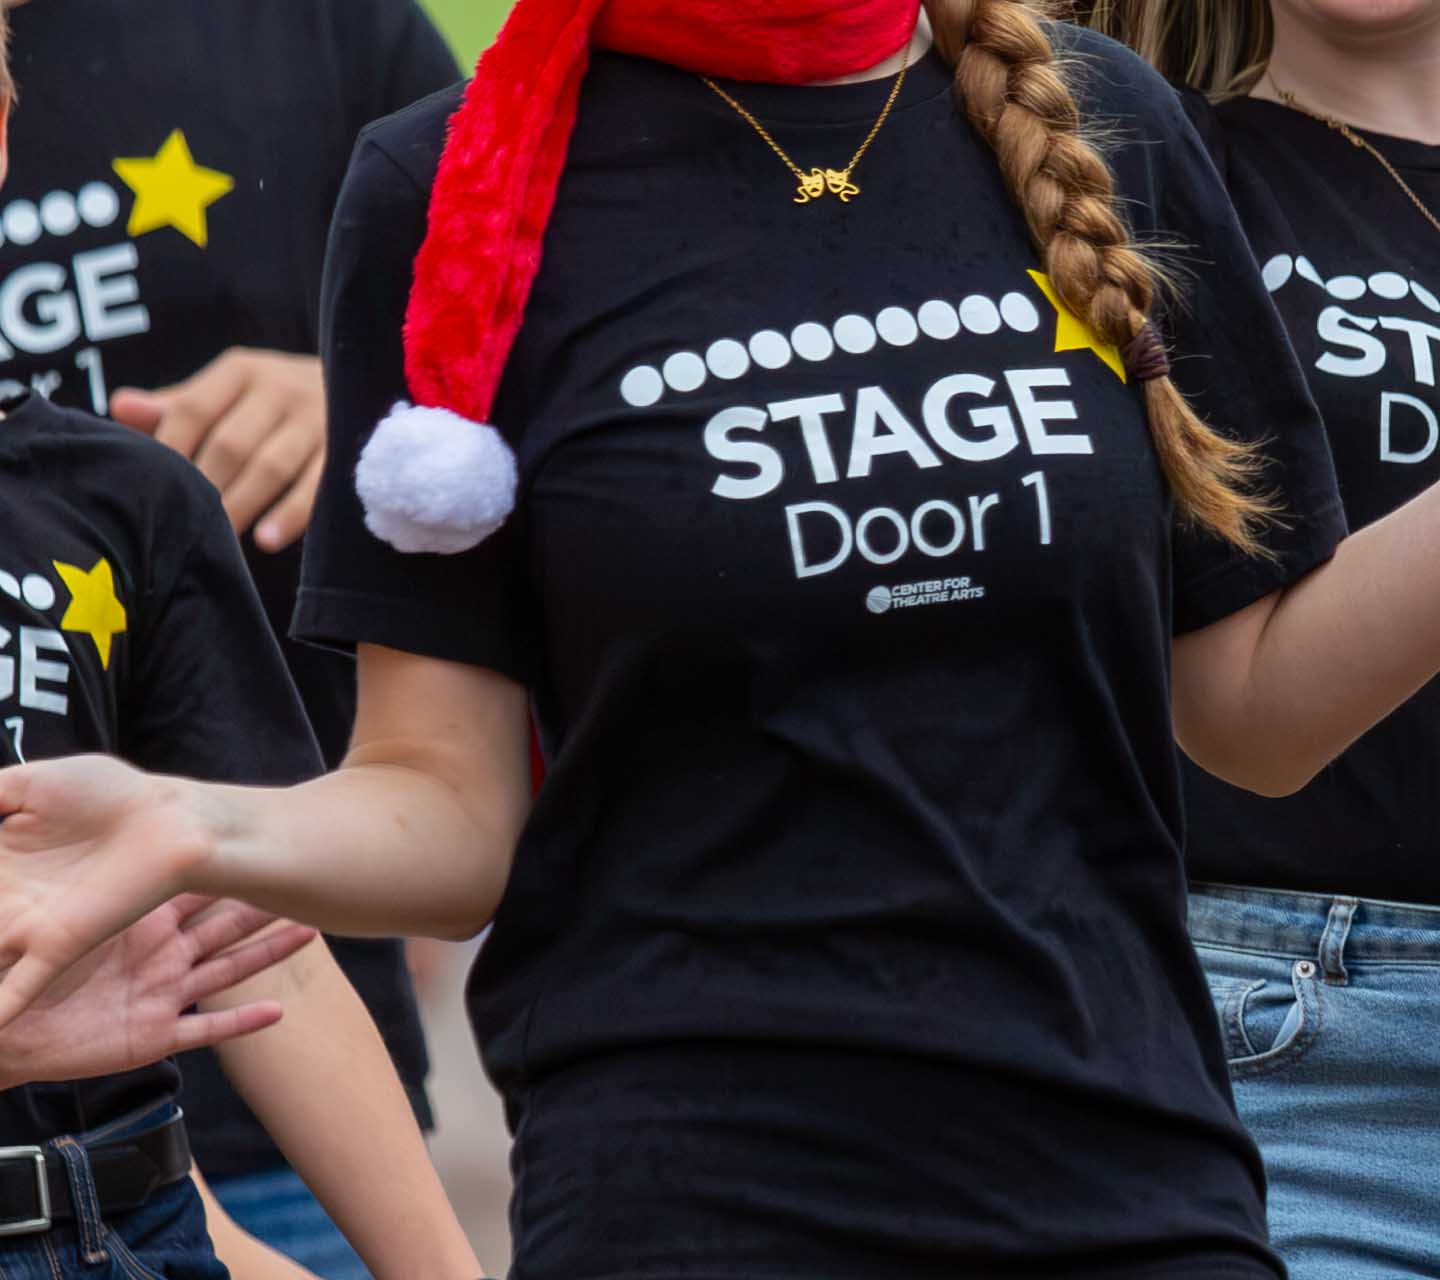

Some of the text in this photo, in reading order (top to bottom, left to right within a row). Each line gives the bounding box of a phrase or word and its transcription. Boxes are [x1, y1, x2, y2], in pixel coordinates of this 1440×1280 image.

[703, 367, 1094, 500] STAGE
[784, 471, 1052, 580] Door 1
[891, 576, 971, 597] CENTER FOR
[892, 586, 985, 608] THEATRE ARTS
